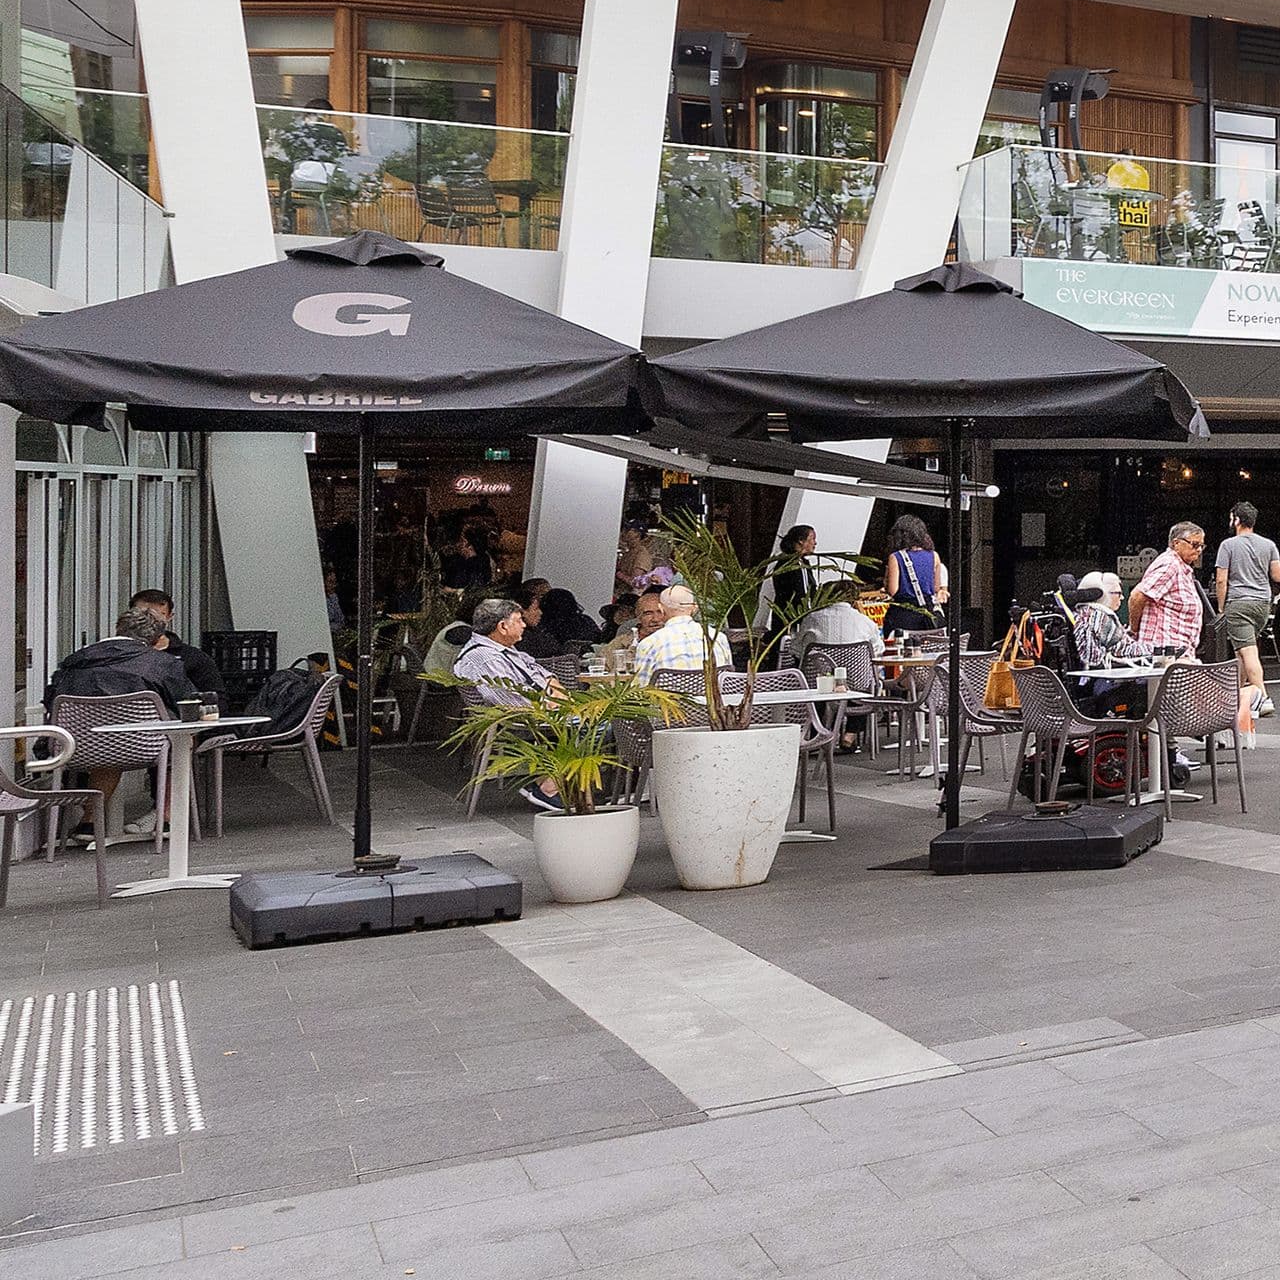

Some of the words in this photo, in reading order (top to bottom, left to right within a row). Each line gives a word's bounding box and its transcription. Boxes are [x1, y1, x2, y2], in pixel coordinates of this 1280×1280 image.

[1056, 269, 1087, 282] THE
[1056, 287, 1176, 309] EVERGREEN
[292, 292, 413, 336] G
